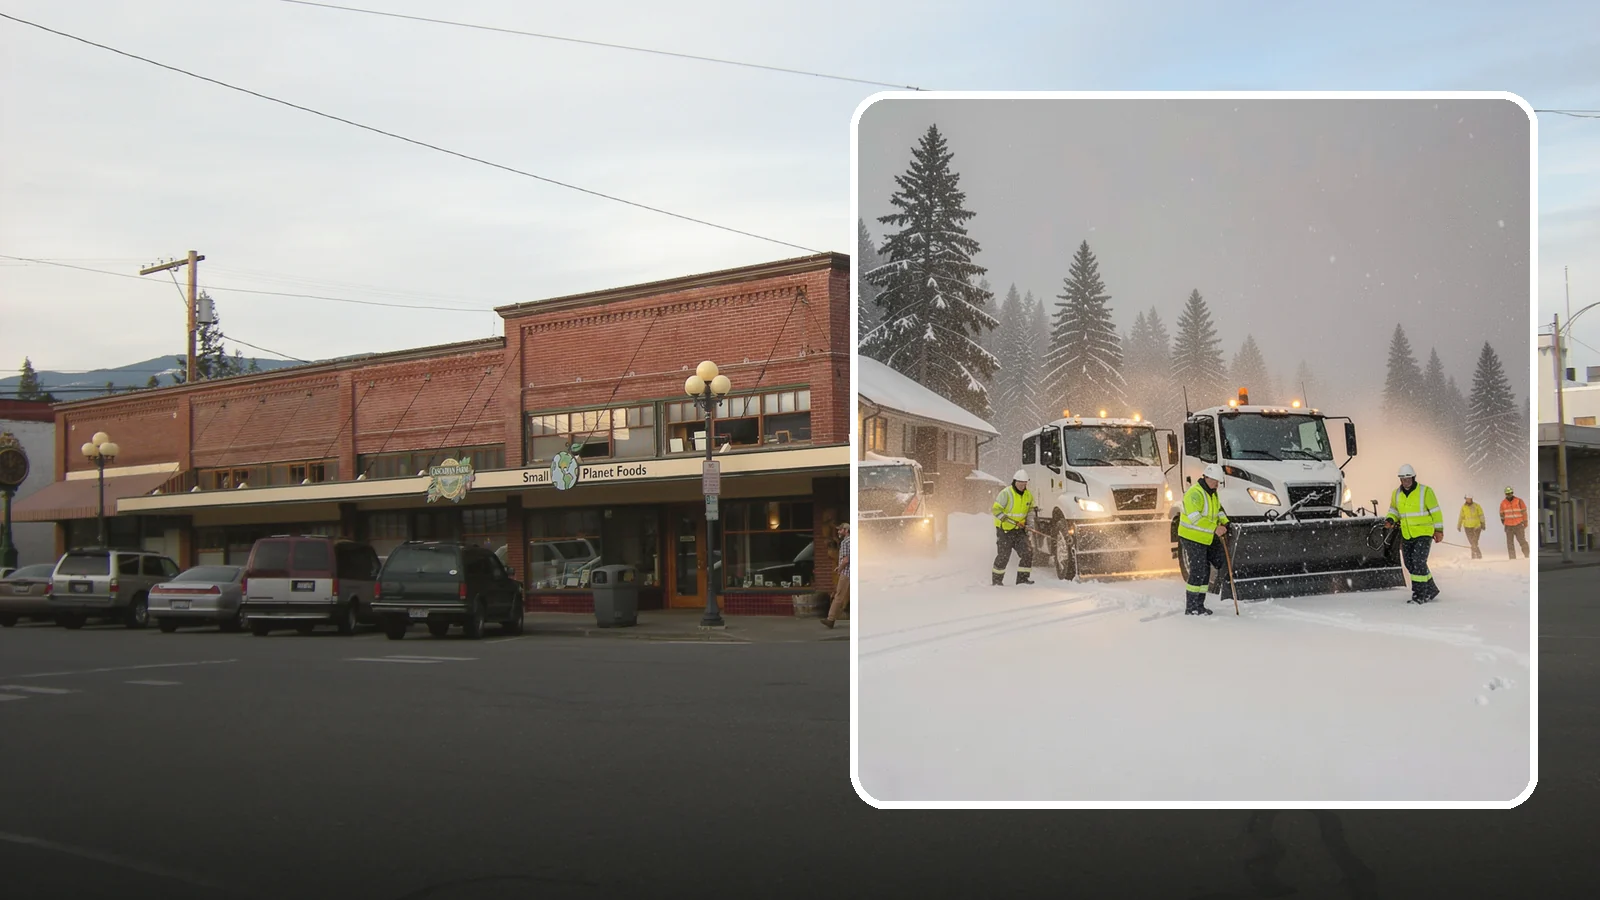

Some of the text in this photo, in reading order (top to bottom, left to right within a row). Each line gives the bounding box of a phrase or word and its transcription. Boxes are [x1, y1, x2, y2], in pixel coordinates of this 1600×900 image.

[523, 464, 647, 483] Small Planet Foods
